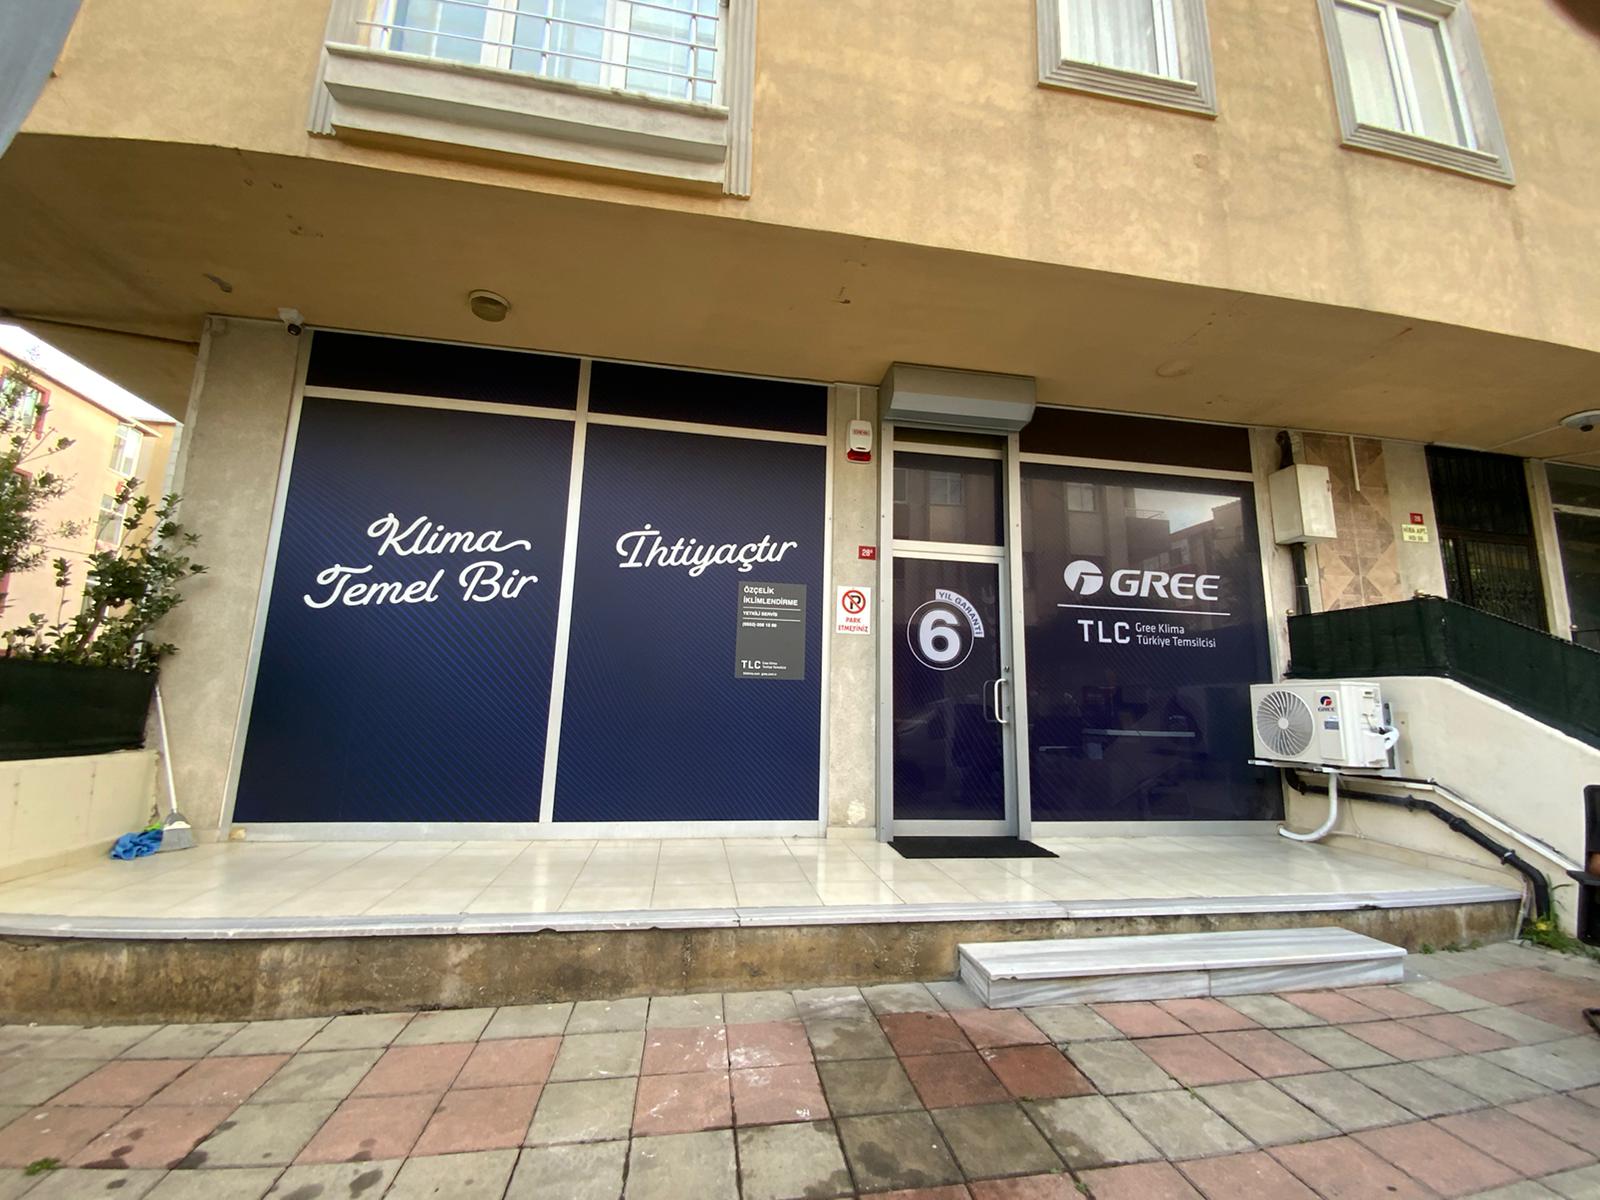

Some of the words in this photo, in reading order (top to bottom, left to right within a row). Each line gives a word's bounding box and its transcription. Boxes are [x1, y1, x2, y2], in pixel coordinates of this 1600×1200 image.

[367, 512, 532, 556] Klima
[615, 523, 798, 578] İhtiyaçtır
[303, 563, 446, 609] Temel
[458, 560, 539, 602] Bir
[743, 585, 775, 595] ÖZÇELİK
[1109, 569, 1221, 601] GREE
[743, 595, 799, 606] İKLİMLENDİRME
[938, 591, 953, 601] YIL
[919, 609, 961, 662] 6
[1077, 619, 1131, 644] TLC
[1135, 622, 1156, 633] Gree
[1158, 623, 1185, 634] Klima
[1136, 634, 1170, 648] Türkiye
[1172, 635, 1217, 648] Temsilcisi
[741, 660, 761, 669] TLC
